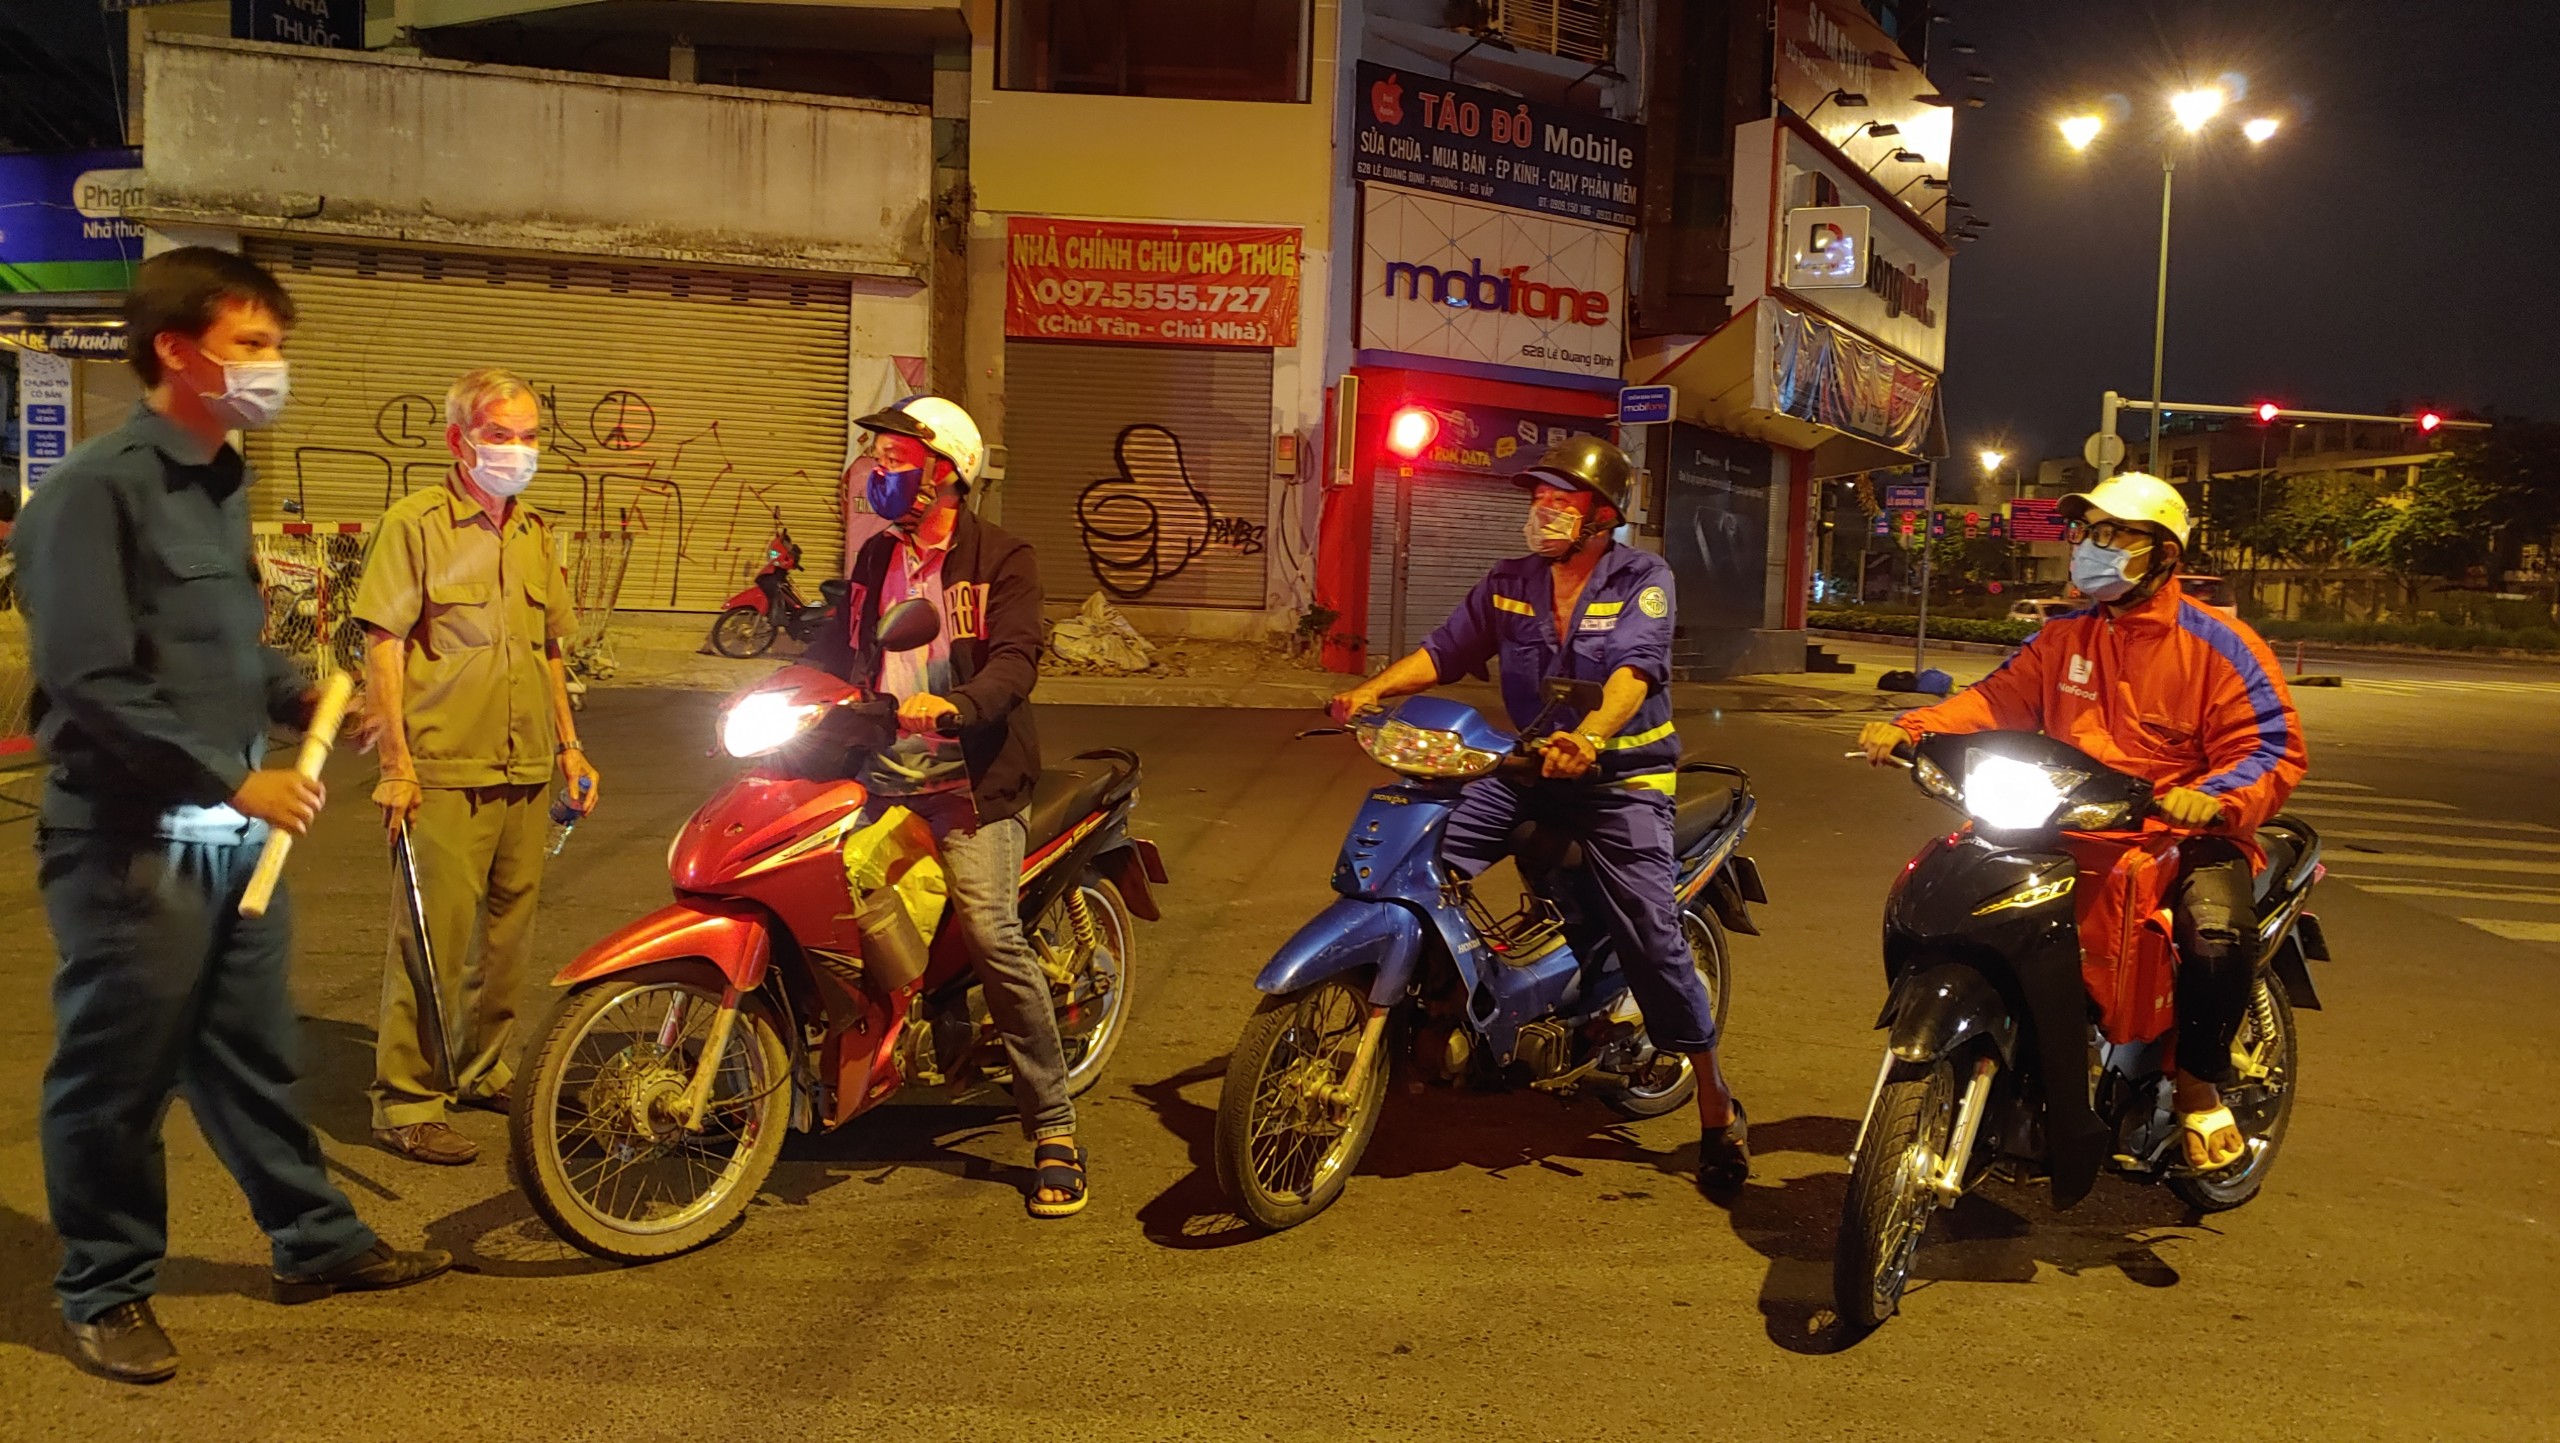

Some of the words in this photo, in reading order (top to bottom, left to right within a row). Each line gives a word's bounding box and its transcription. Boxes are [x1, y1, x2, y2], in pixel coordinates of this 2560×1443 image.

[1418, 91, 1480, 138] TÁO
[1491, 104, 1533, 148] ĐỎ
[1544, 123, 1634, 169] Mobile
[1357, 161, 1371, 175] 628
[1372, 163, 1382, 178] LÊ
[1383, 166, 1407, 181] QUANG
[1360, 126, 1385, 156] SỬA
[1432, 146, 1458, 170] MUA
[1462, 149, 1486, 176] BÁN
[1495, 155, 1510, 179] ÉP
[1513, 160, 1540, 186] KÍNH
[1549, 169, 1579, 196] CHẠY
[1581, 172, 1610, 199] PHẦN
[1012, 226, 1060, 268] NHÀ
[1065, 229, 1133, 271] CHÍNH
[1137, 229, 1183, 273] CHỦ
[1187, 242, 1233, 275] CHO
[1238, 234, 1296, 277] THUÊ
[1036, 278, 1270, 313] 097.5555.727
[1385, 257, 1609, 327] mobifone
[80, 331, 128, 350] KHÔNG
[1037, 313, 1092, 335] (Chú
[1096, 317, 1140, 337] Tân
[1160, 316, 1206, 339] Chủ
[1211, 322, 1267, 342] Nhà)
[1522, 344, 1545, 358] 628
[1561, 349, 1591, 367] Quang
[1372, 793, 1409, 805] HONDA
[1457, 938, 1481, 954] HONDA
